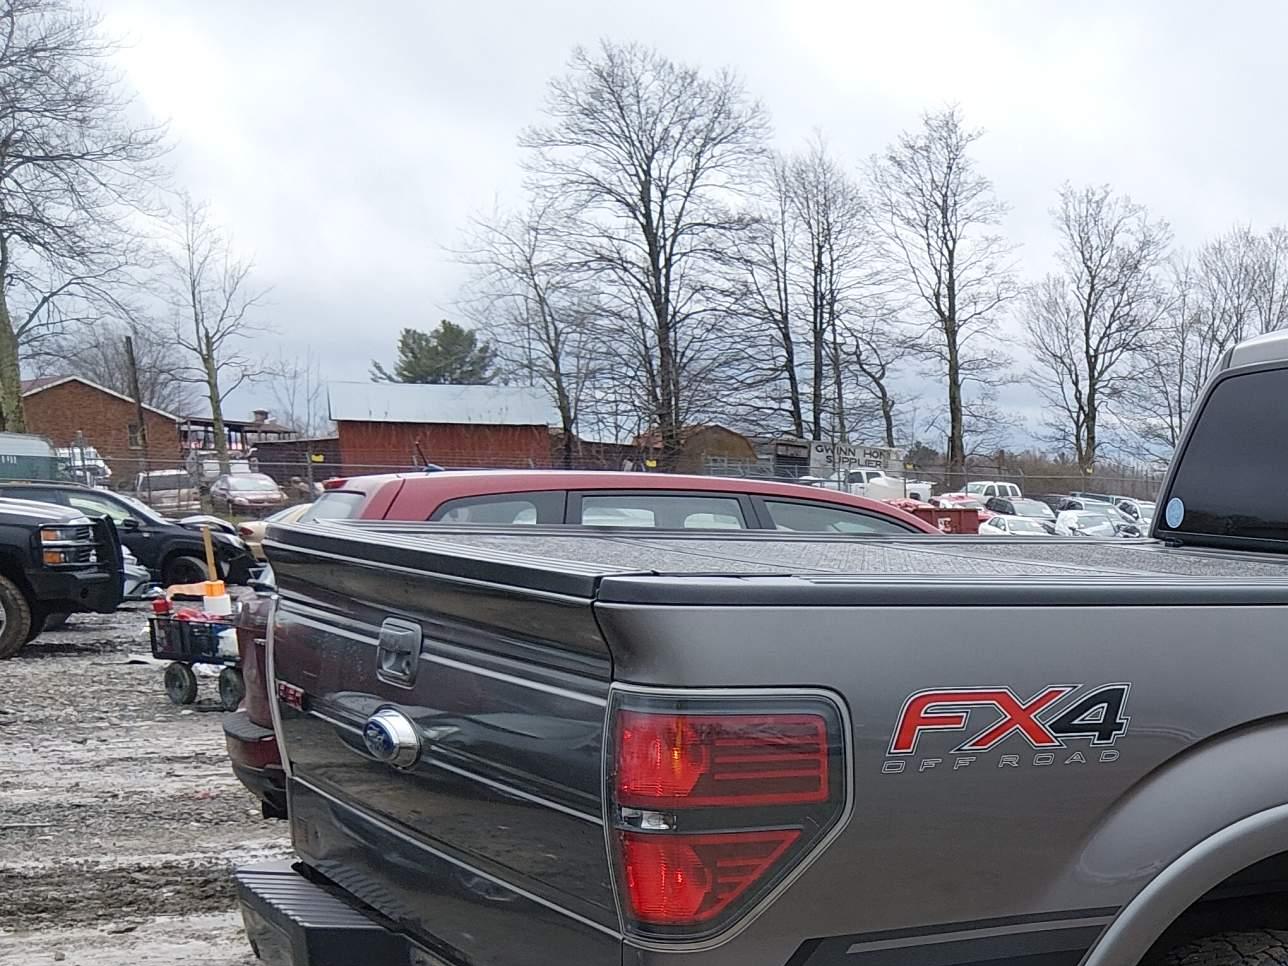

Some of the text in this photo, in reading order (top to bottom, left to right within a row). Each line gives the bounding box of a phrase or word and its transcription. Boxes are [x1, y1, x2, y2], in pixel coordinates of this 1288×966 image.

[815, 444, 856, 457] GWINN
[886, 682, 1132, 756] FX4
[881, 749, 1121, 775] OFF ROAD
